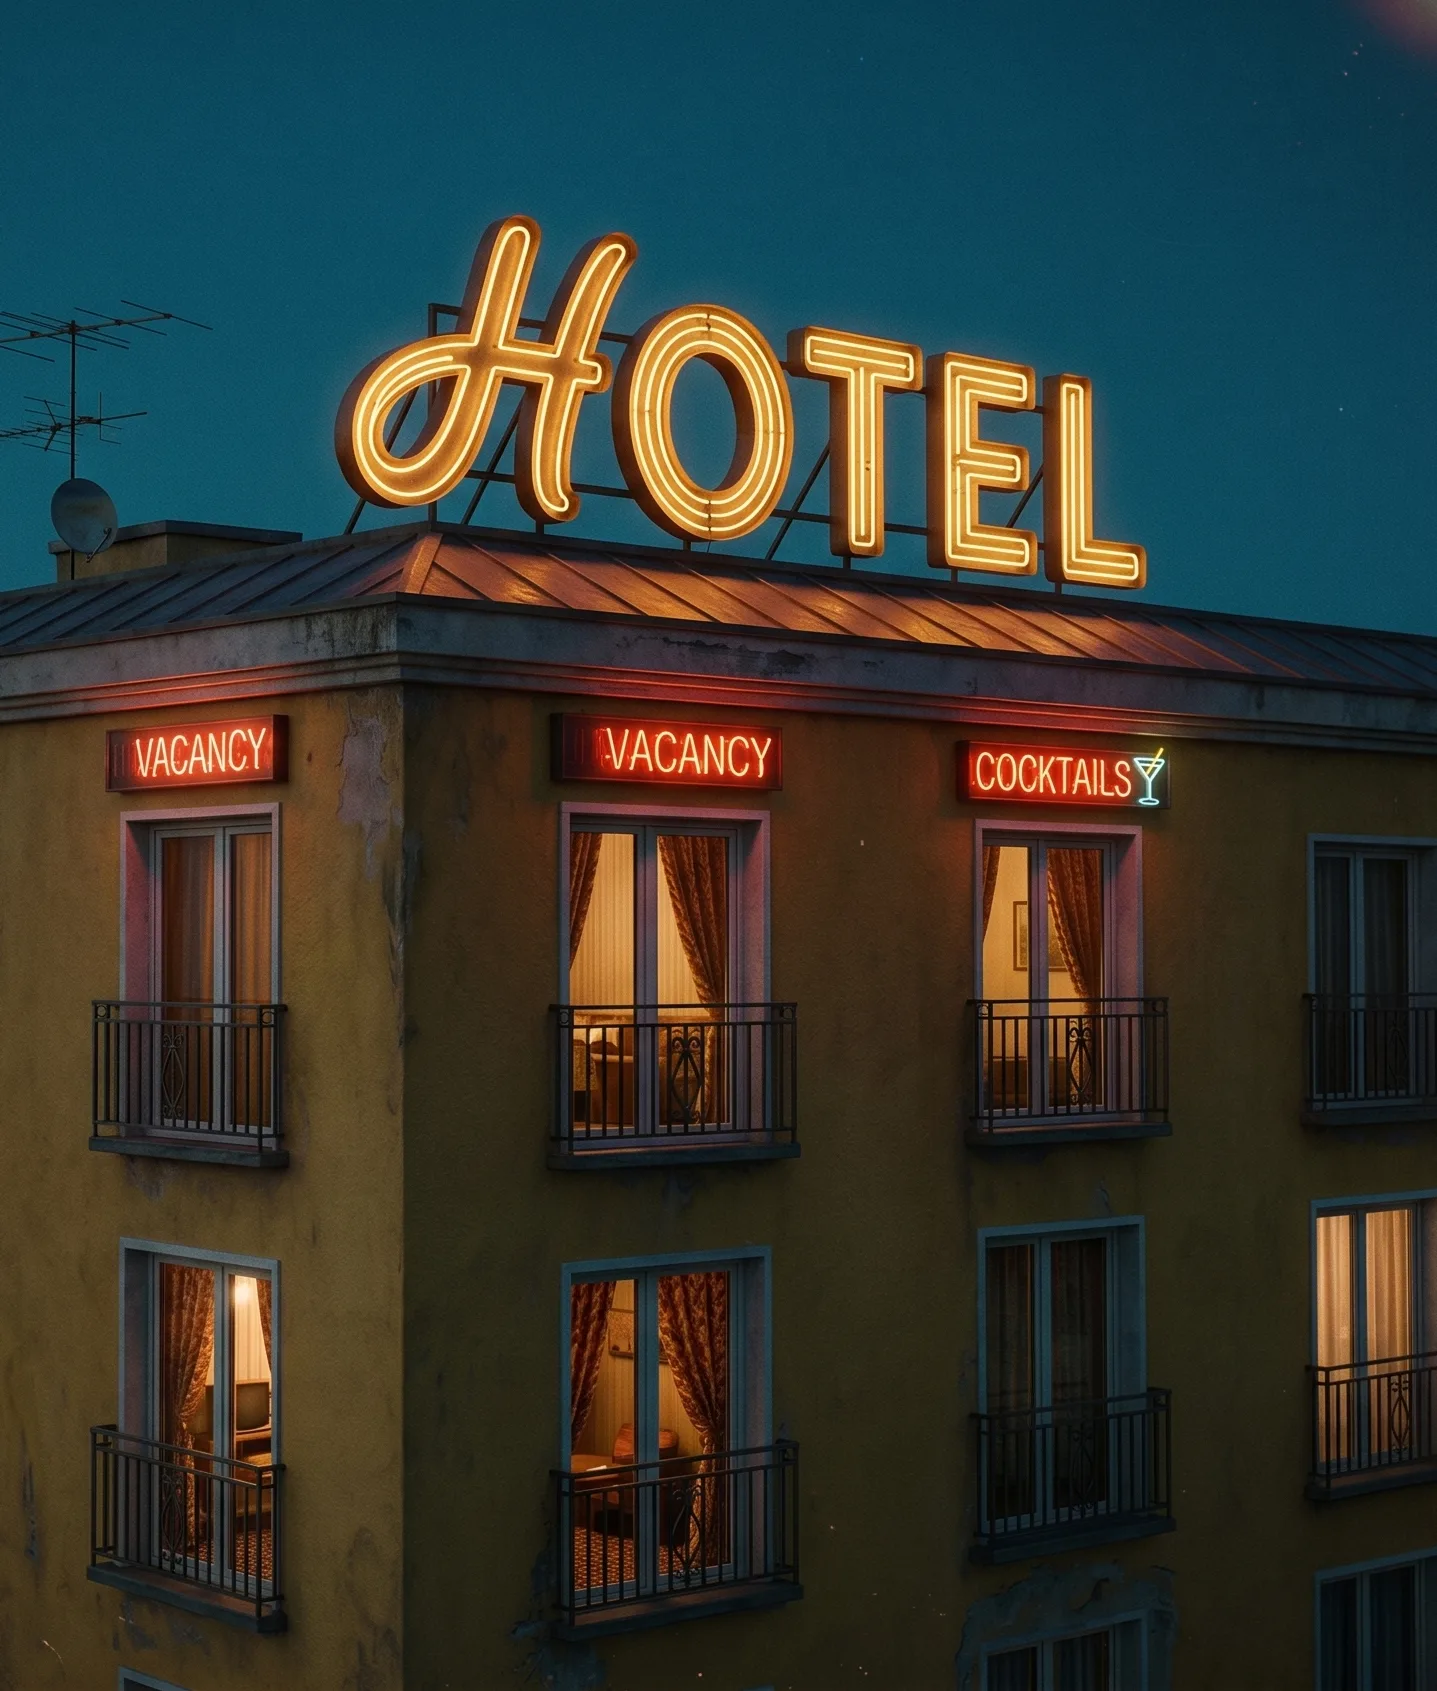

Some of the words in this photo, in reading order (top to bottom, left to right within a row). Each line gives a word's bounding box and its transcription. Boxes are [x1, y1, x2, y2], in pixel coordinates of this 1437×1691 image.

[336, 215, 1146, 590] HOTEL
[135, 727, 267, 778] VACANCY
[606, 727, 772, 779] VACANCY
[975, 751, 1132, 797] COCKTAILS
